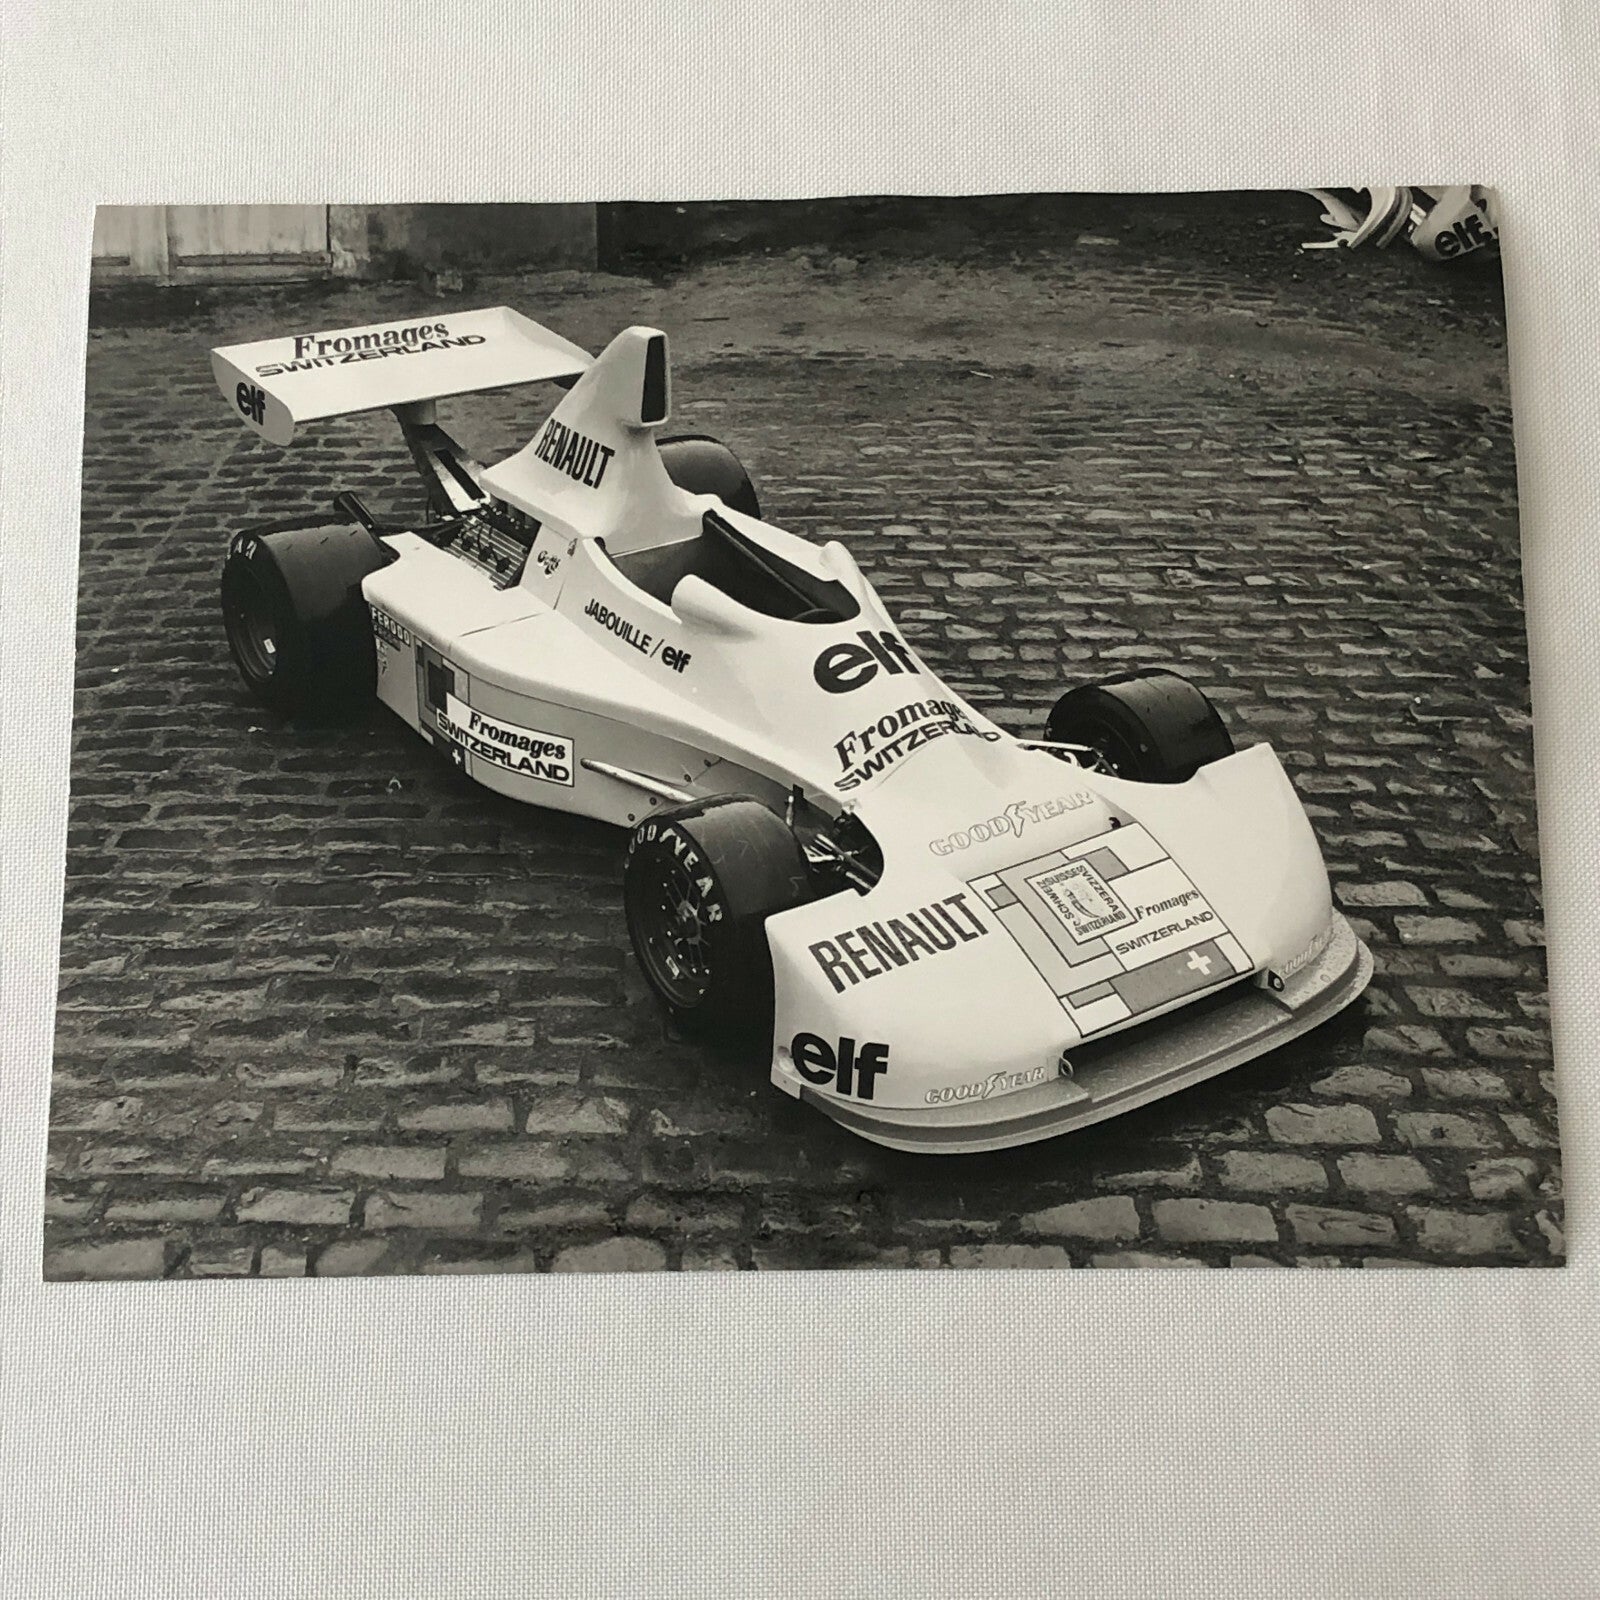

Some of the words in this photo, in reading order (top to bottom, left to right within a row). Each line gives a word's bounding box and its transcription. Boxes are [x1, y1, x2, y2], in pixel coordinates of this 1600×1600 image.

[1435, 214, 1483, 257] elf
[256, 334, 486, 377] SWITZERLAND
[294, 322, 449, 359] Fromages
[236, 382, 265, 426] elf
[534, 418, 615, 489] RENAULT
[371, 606, 410, 645] FERODO
[584, 598, 652, 655] JABOUILLE
[661, 646, 692, 674] elf
[813, 630, 920, 694] elf
[438, 712, 569, 782] SWITZERLAND
[469, 711, 566, 760] Fromages
[1077, 864, 1119, 912] SVIZZERA
[1134, 889, 1199, 921] Fromages
[808, 893, 989, 994] RENAULT
[1075, 910, 1127, 936] SWITZERLAND
[1116, 911, 1214, 955] SWITZERLAND
[790, 1032, 889, 1100] elf
